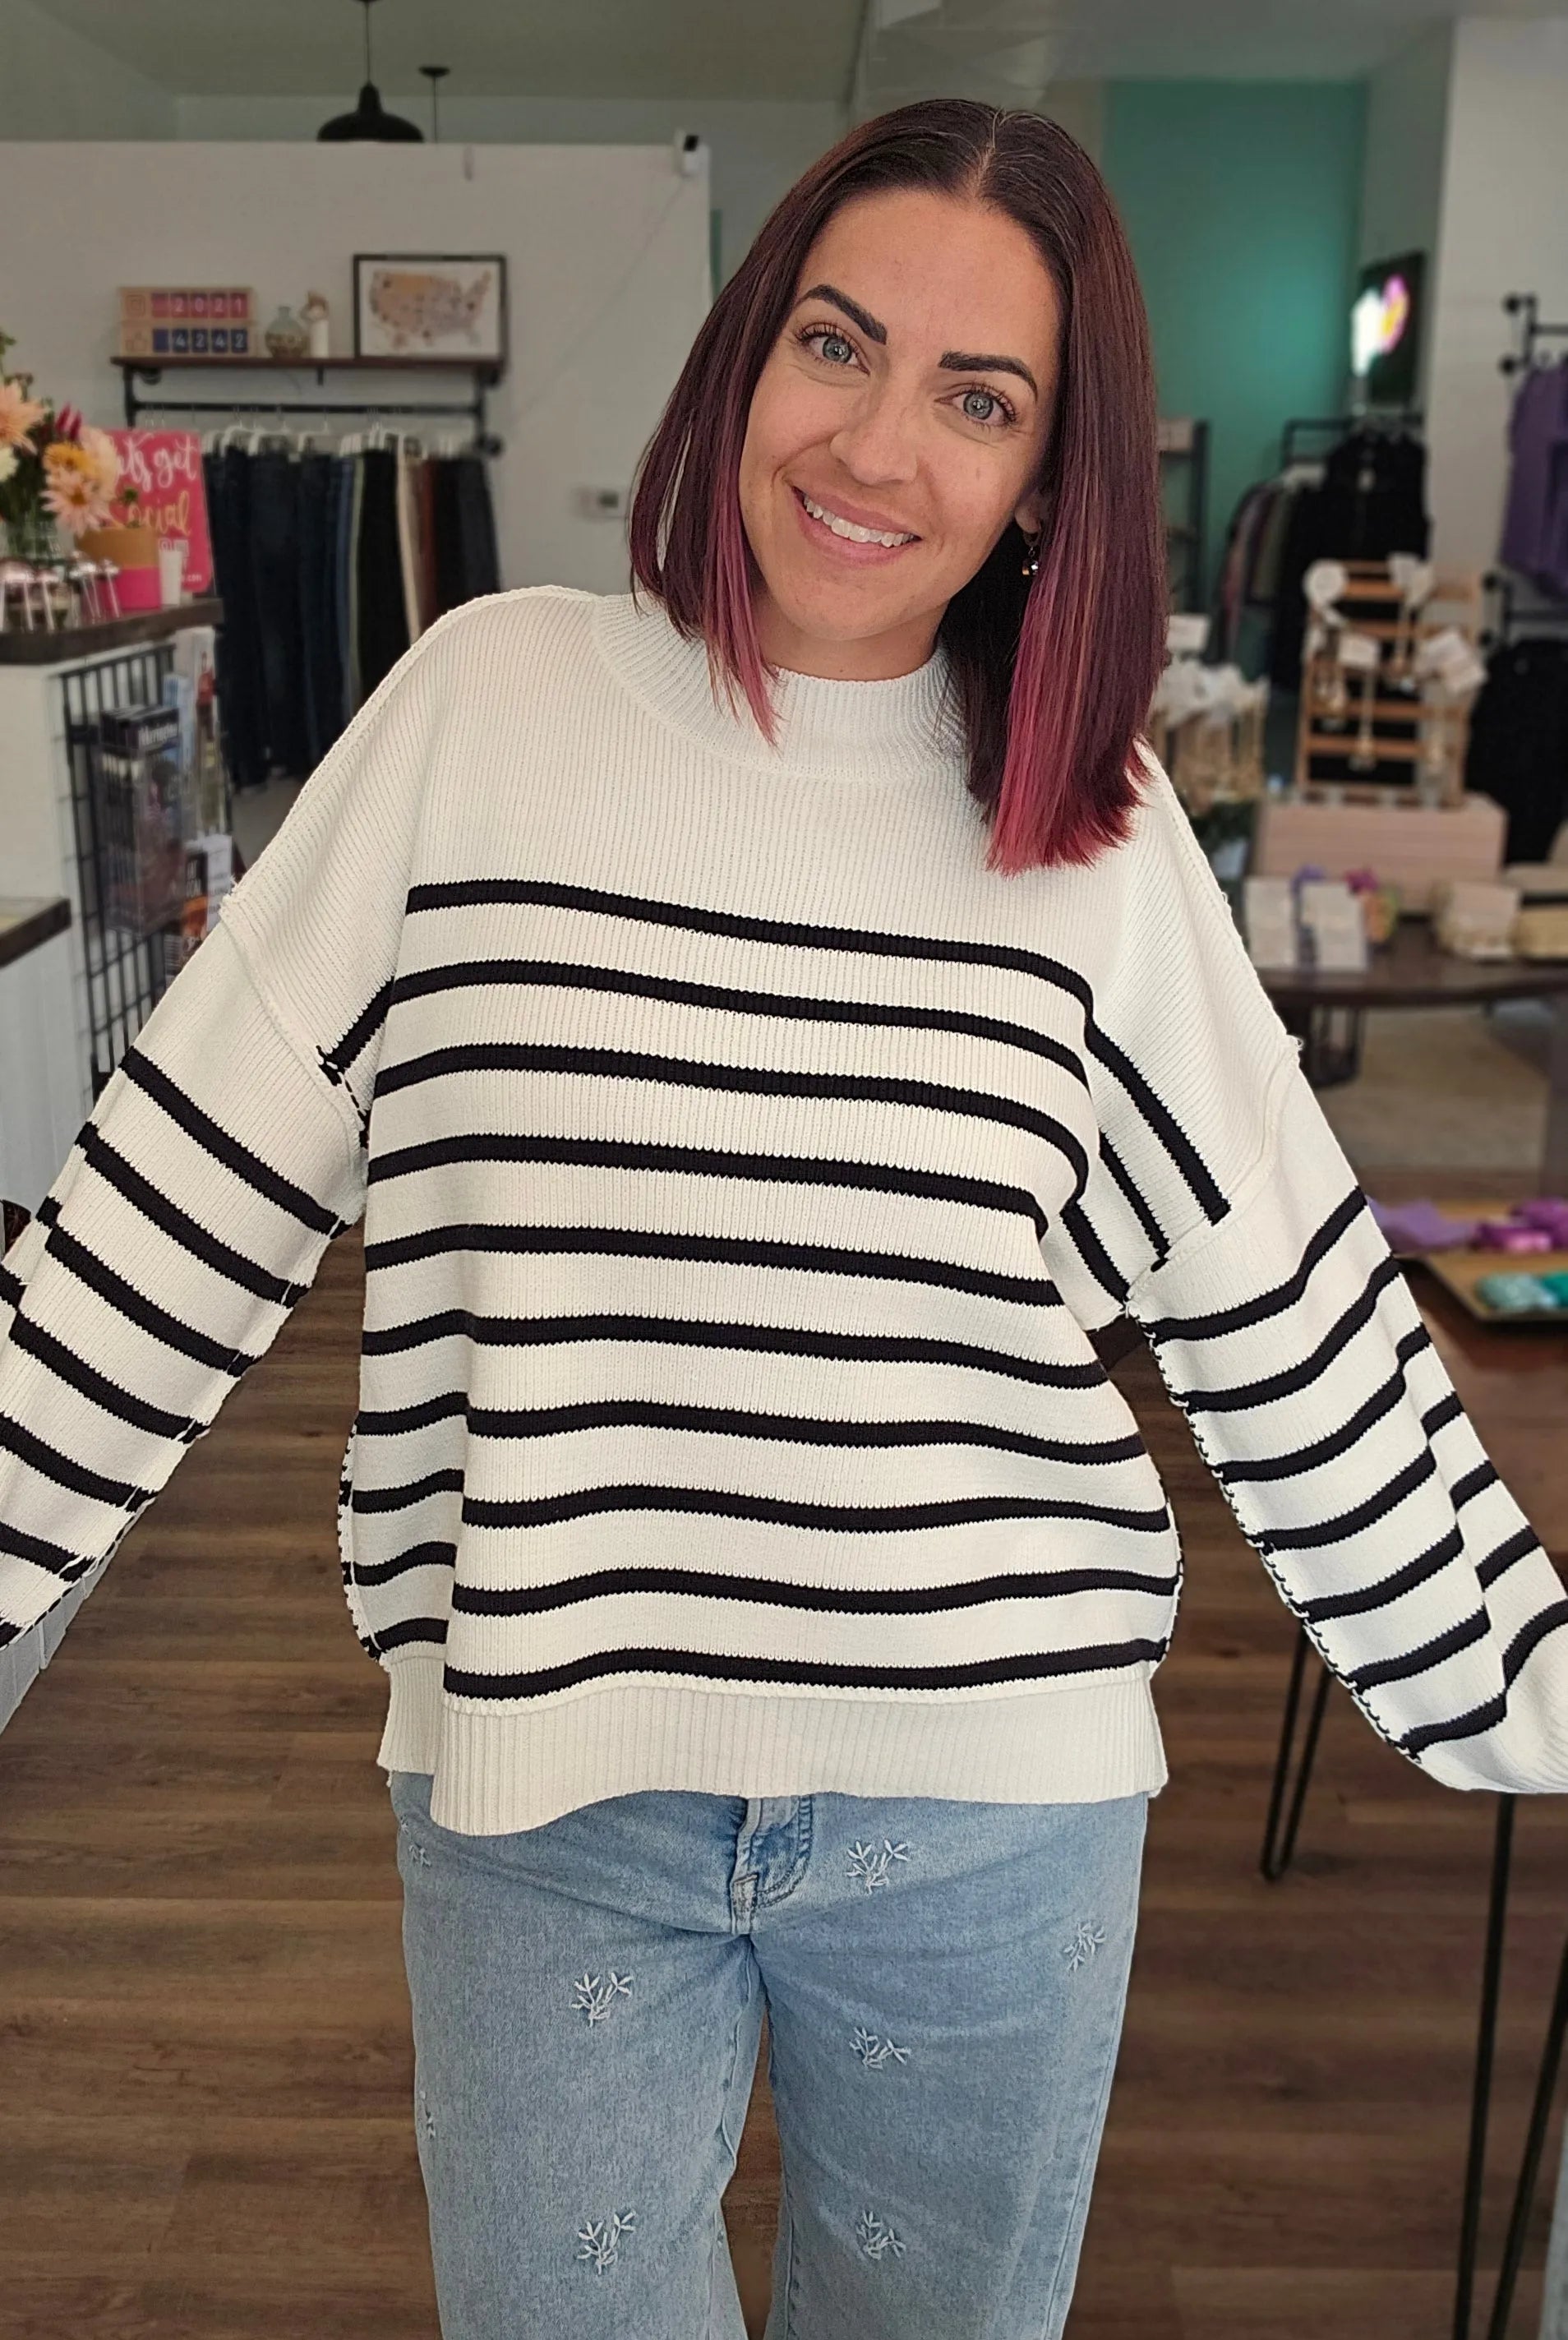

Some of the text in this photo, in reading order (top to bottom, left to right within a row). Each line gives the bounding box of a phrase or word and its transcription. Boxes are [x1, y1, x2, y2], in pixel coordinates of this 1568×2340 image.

[174, 297, 242, 313] 2021
[175, 333, 244, 348] 4242
[154, 435, 198, 488] get
[125, 490, 191, 536] ocial
